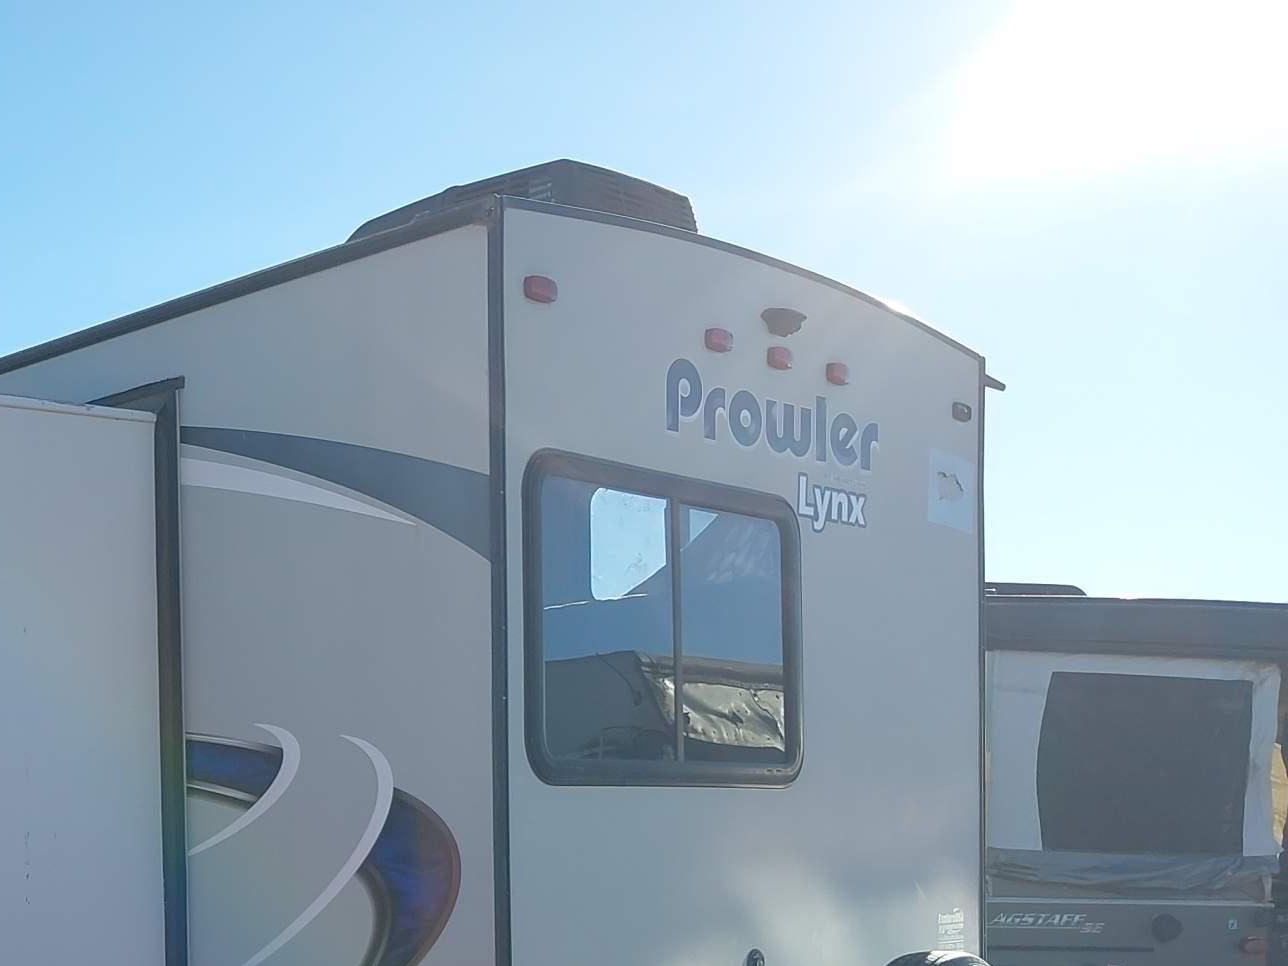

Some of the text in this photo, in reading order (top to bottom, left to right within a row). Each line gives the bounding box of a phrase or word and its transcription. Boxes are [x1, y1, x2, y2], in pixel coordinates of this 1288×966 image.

[665, 357, 881, 472] Prowler
[797, 471, 867, 533] Lynx
[987, 912, 1087, 926] AGSTAFF
